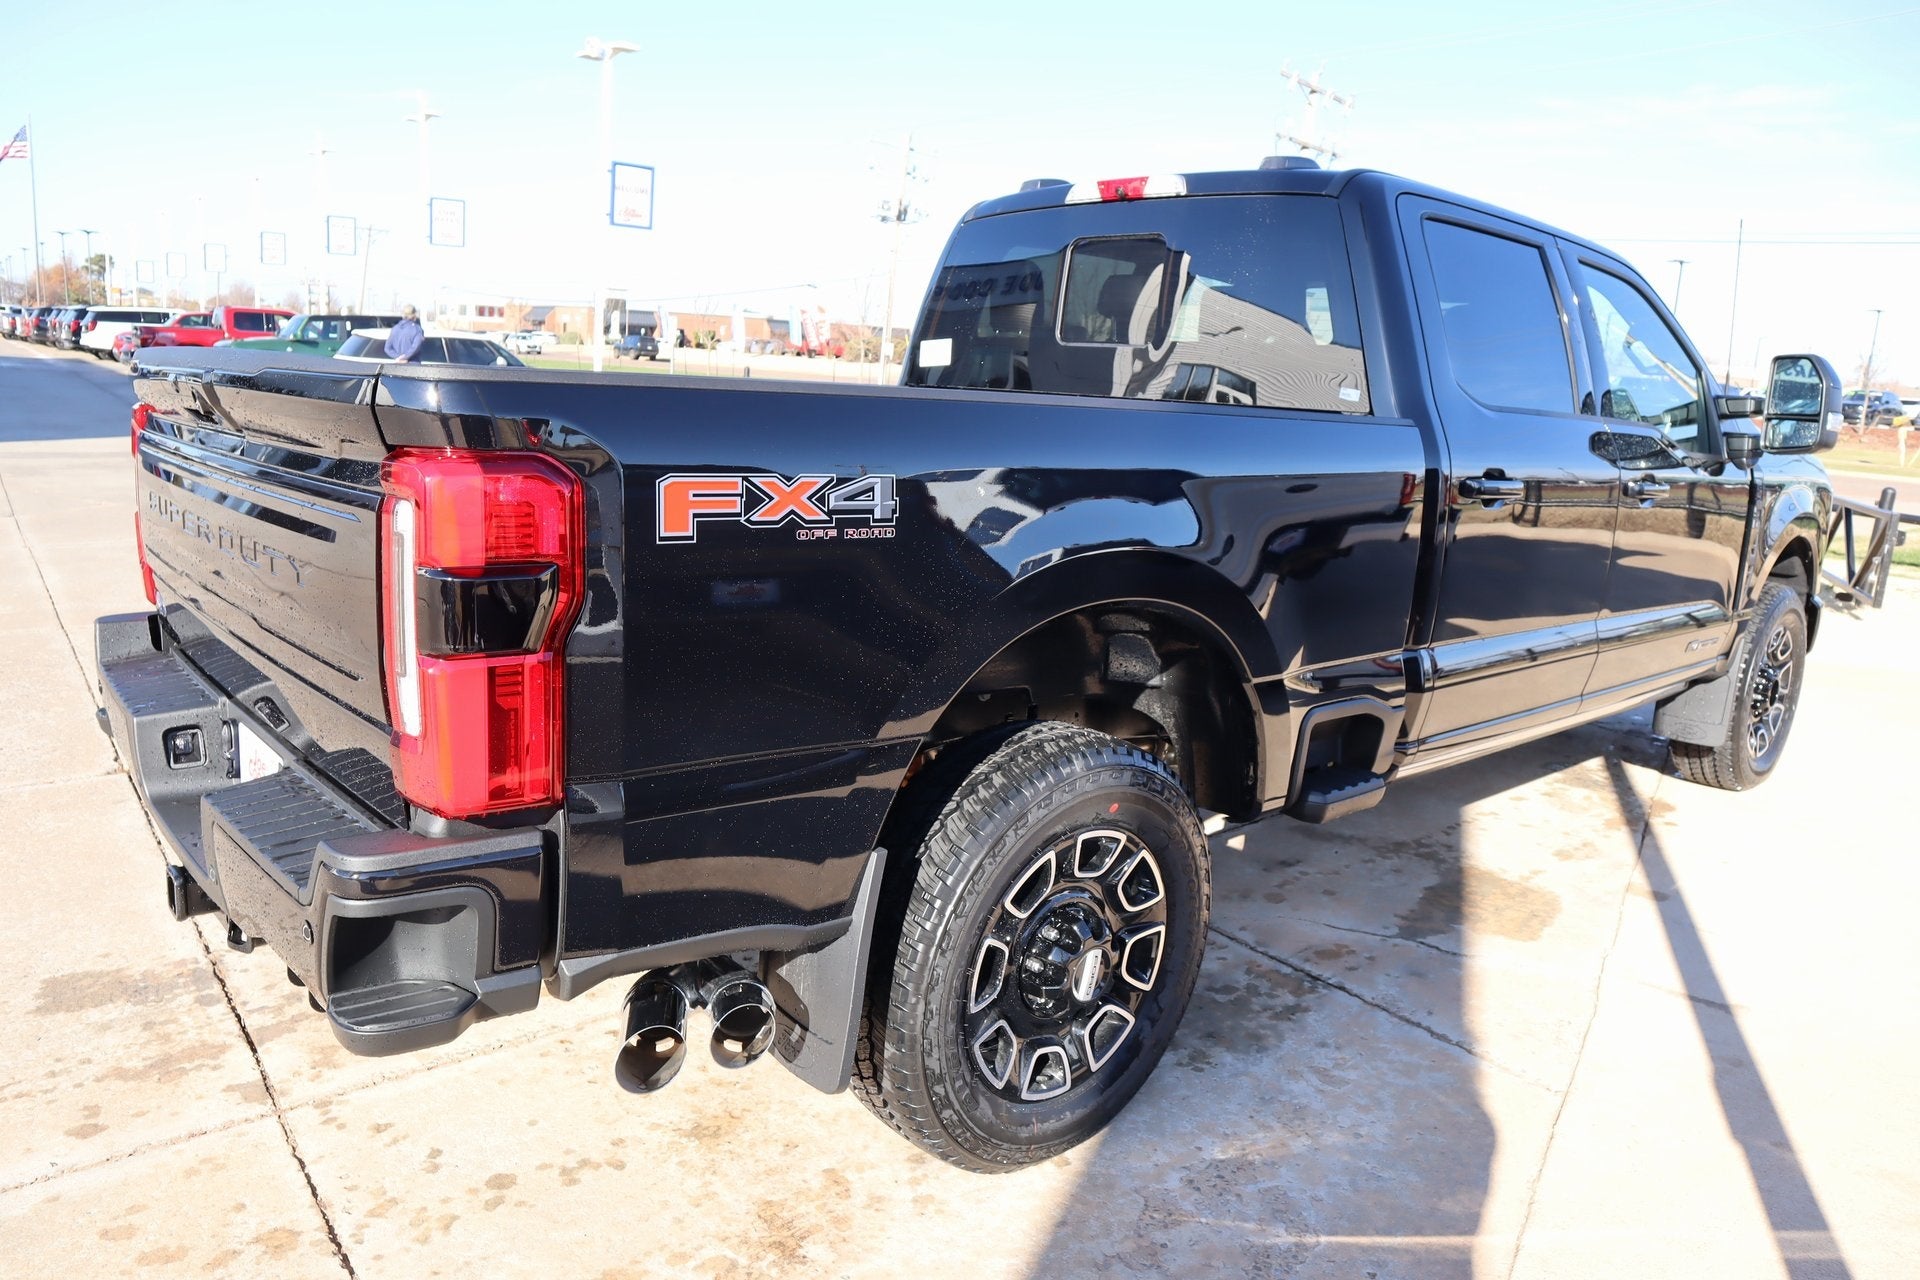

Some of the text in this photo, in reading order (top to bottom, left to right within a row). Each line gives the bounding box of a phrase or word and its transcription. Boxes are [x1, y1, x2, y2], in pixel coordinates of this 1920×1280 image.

[149, 490, 314, 588] SUPER DUTY
[656, 473, 899, 544] FX4
[796, 528, 896, 541] OFF ROAD
